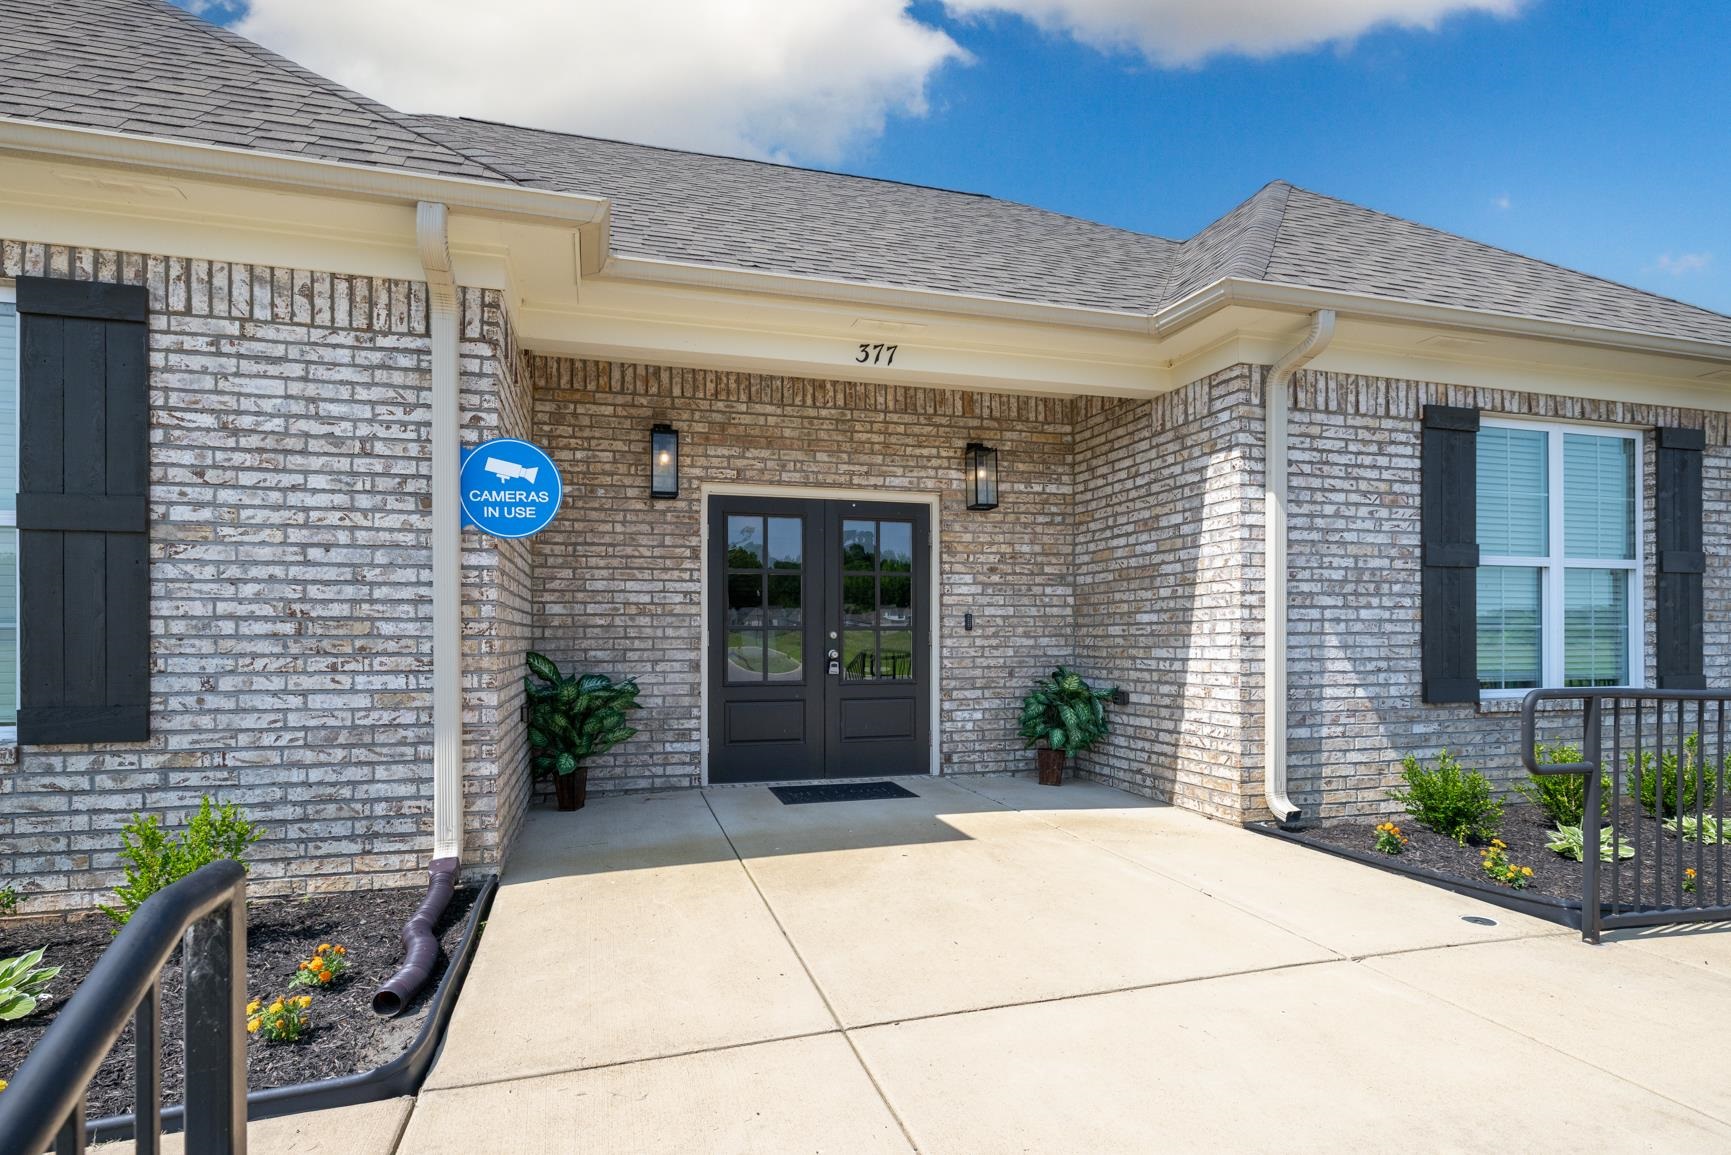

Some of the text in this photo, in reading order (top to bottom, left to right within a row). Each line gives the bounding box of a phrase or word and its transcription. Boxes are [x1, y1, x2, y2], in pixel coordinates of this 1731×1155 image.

[856, 344, 898, 366] 377
[469, 489, 550, 503] CAMERAS
[483, 506, 537, 518] IN USE
